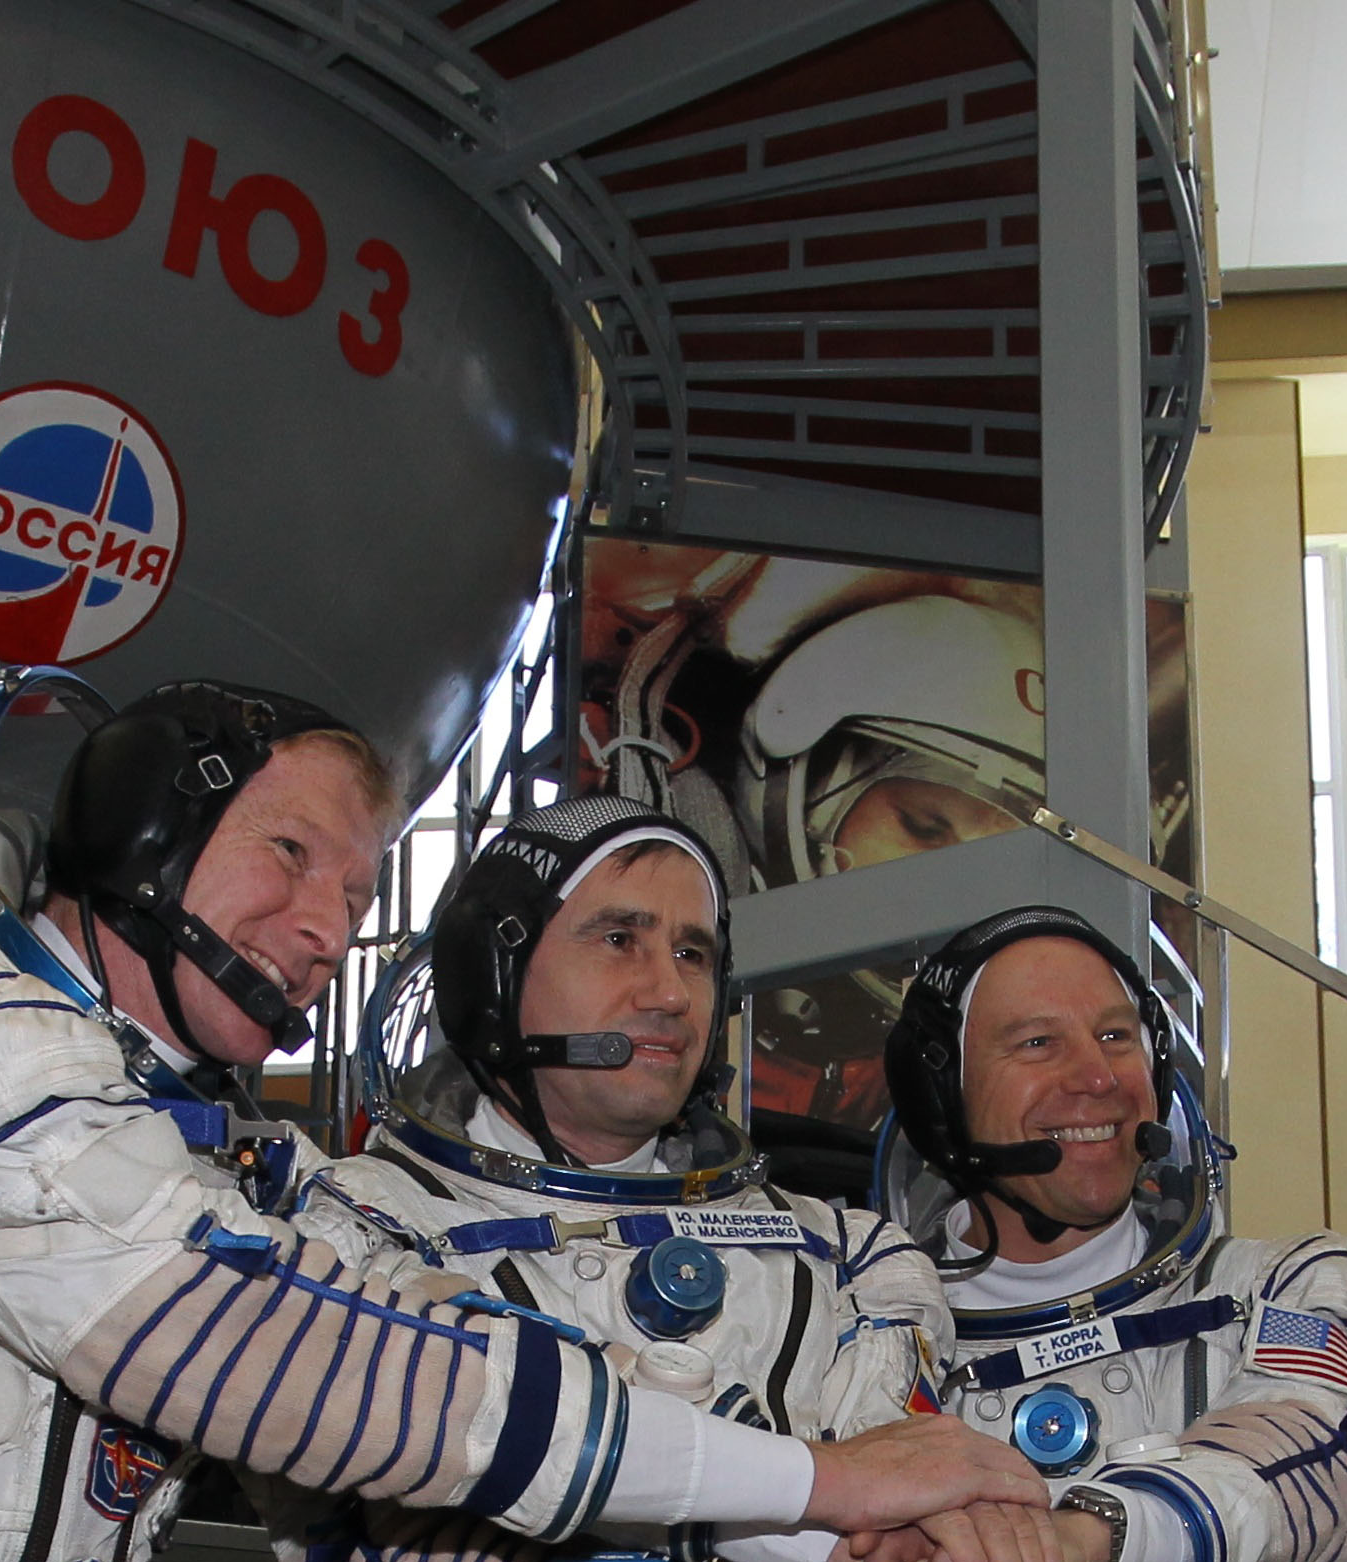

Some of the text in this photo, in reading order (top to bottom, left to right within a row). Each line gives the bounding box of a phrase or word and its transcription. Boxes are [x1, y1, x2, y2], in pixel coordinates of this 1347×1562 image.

[675, 1211, 793, 1227] Ю. МАЛЕНЧЕНКО
[680, 1225, 798, 1238] U. MALENCHENKO
[1031, 1325, 1102, 1354] T. KOPRA
[1035, 1341, 1105, 1369] Т. КОПРА
